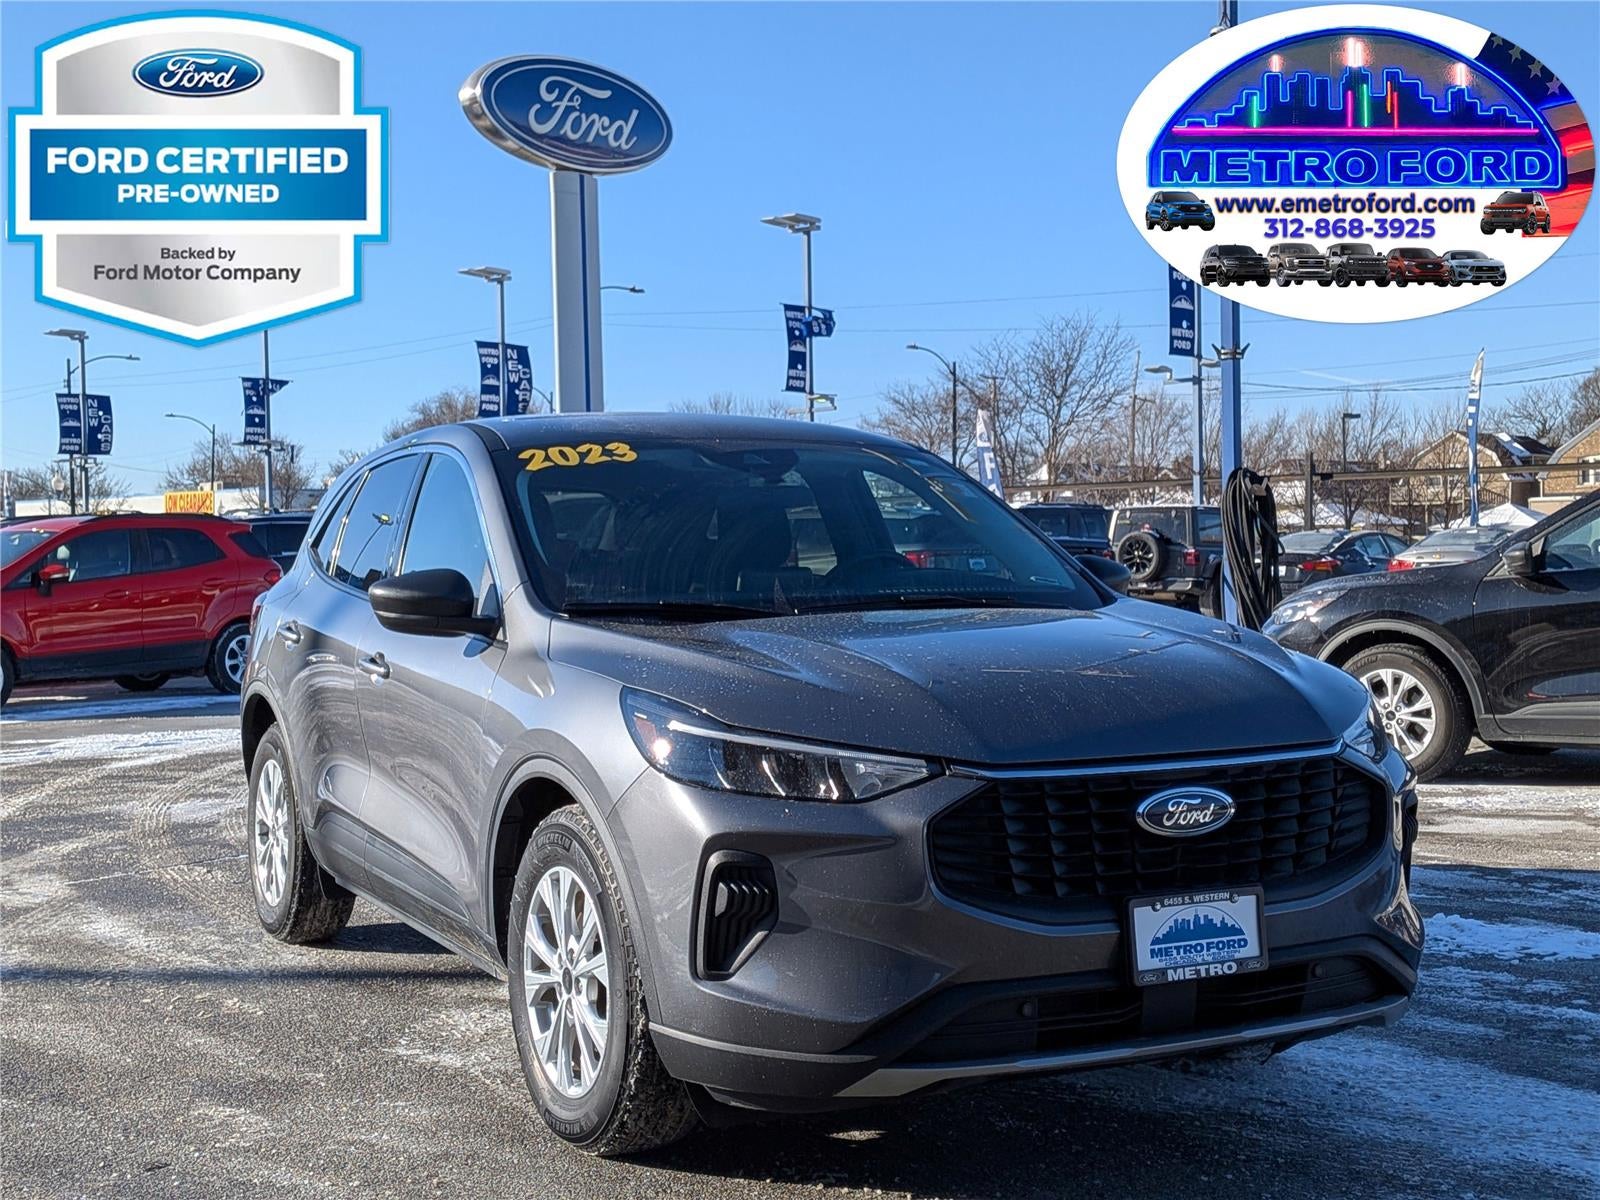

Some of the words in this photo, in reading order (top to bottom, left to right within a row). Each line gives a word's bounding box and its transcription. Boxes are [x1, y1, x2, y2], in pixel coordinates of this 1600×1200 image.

[529, 76, 639, 150] Ford
[87, 399, 99, 427] NEW
[100, 415, 111, 451] CARS
[518, 442, 638, 471] 2023
[1163, 798, 1215, 826] Ford
[1164, 897, 1183, 906] 6455
[1184, 896, 1192, 904] S.
[1193, 891, 1230, 903] WESTERN
[1150, 942, 1205, 960] METRO
[1206, 938, 1249, 951] FORD
[1167, 961, 1238, 982] METRO
